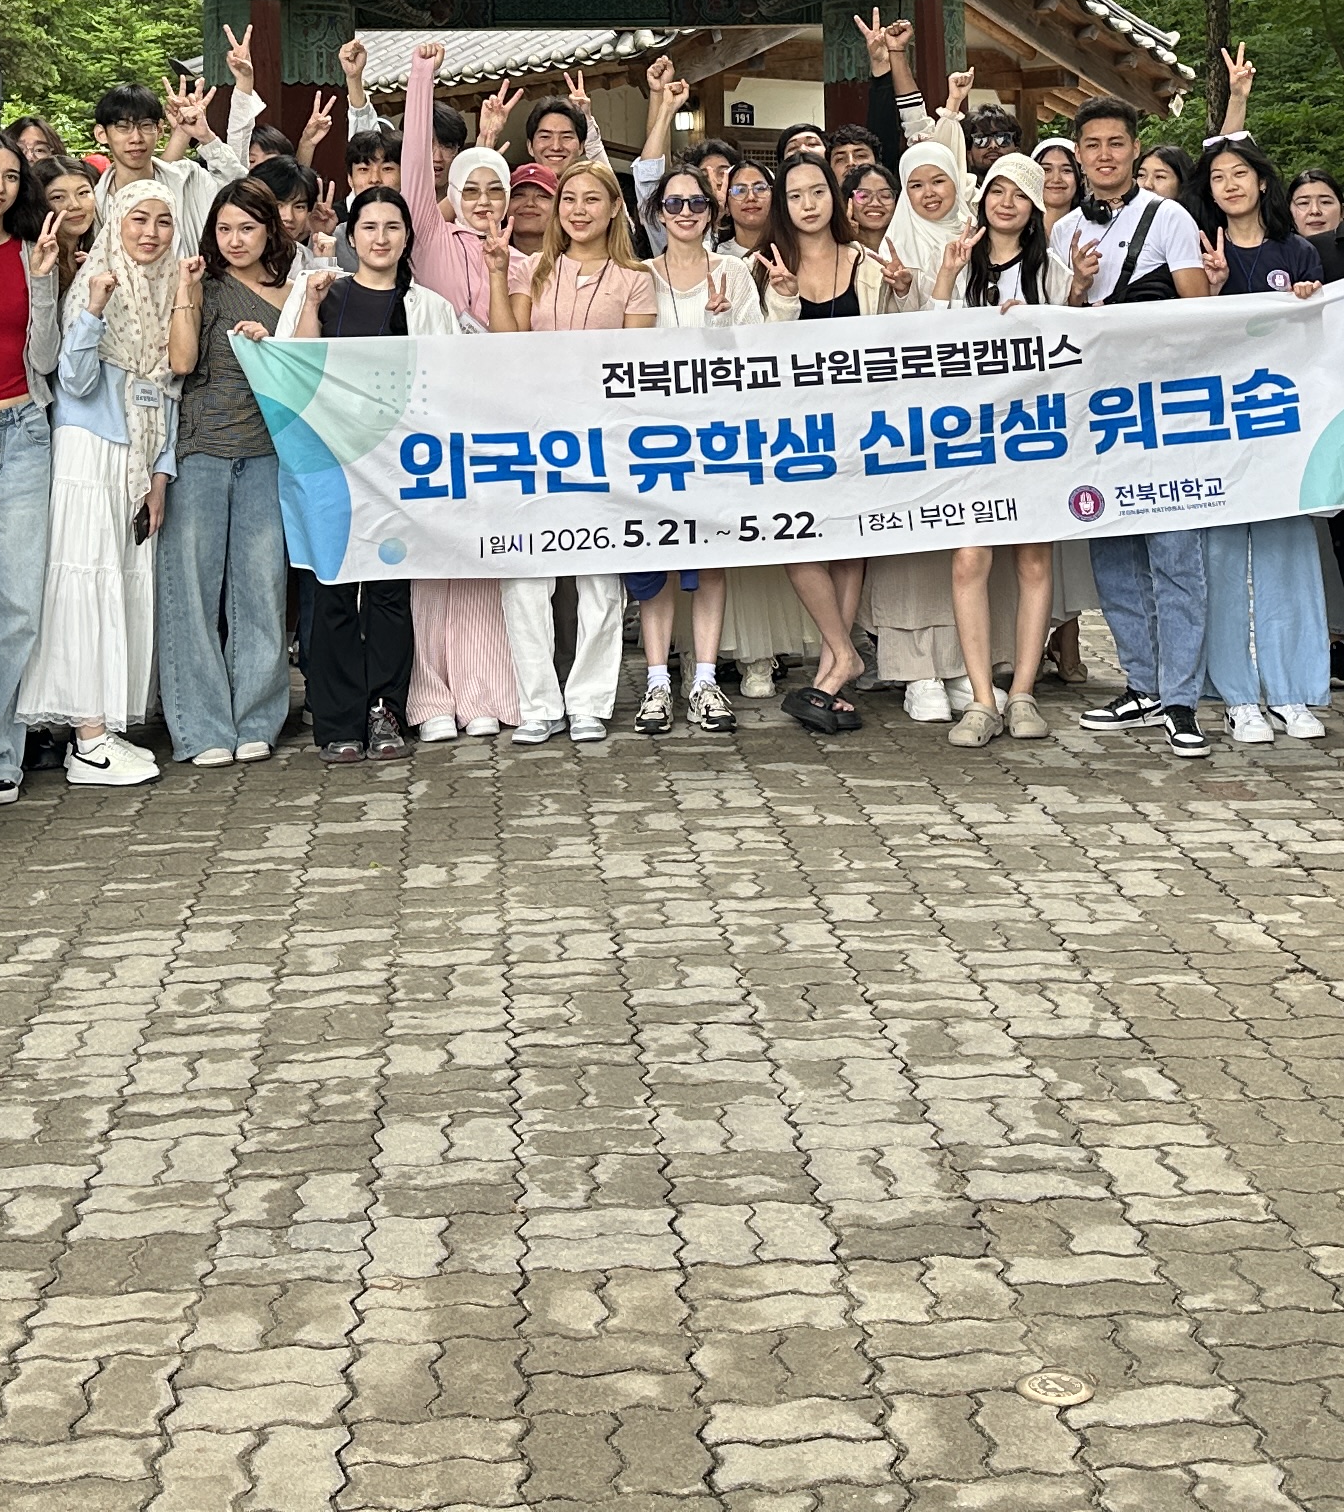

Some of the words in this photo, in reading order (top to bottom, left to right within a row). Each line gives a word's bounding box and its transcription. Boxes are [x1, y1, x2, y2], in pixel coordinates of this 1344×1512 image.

[735, 113, 750, 124] 191
[603, 356, 781, 398] 전북대학교
[792, 335, 1082, 387] 남원글로컬캠퍼스
[400, 429, 608, 499] 외국인
[629, 414, 836, 492] 유학생
[860, 394, 1067, 474] 신입생
[1089, 369, 1300, 453] 워크숍
[1115, 478, 1225, 506] 전북대학교
[920, 503, 965, 528] 부안
[972, 498, 1017, 523] 일대
[1151, 505, 1186, 514] NATIONAL
[1187, 500, 1227, 510] UNIVERSITY
[541, 527, 615, 552] 2026.
